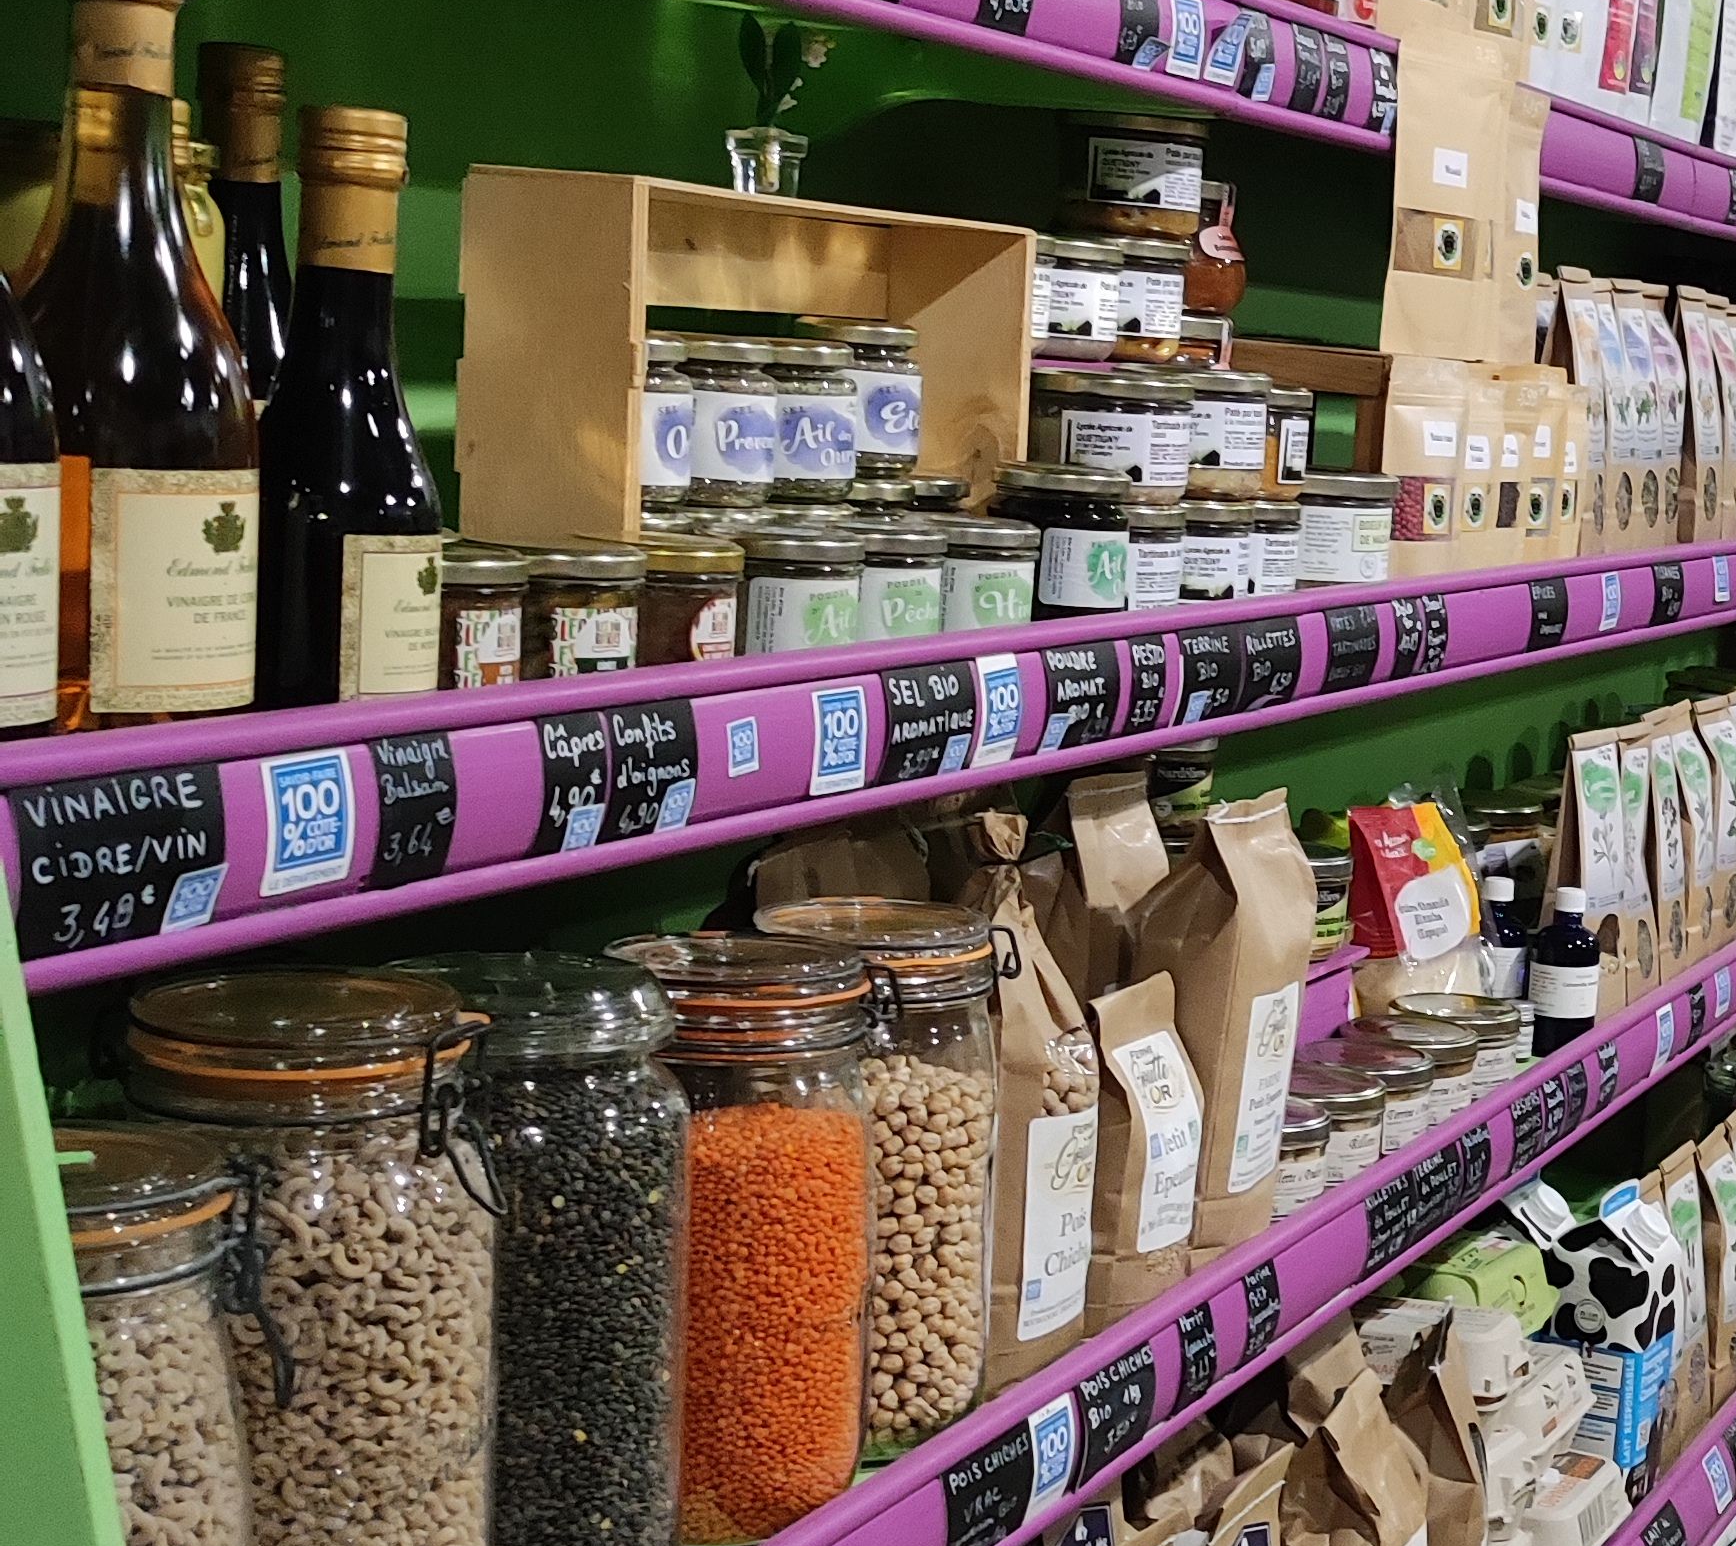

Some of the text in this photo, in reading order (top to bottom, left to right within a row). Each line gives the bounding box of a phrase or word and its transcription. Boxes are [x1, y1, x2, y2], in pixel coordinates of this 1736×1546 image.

[887, 676, 926, 708] SEL
[986, 684, 1021, 715] 100
[612, 710, 678, 761] Confits
[822, 708, 861, 741] 100
[543, 721, 607, 768] Câpres
[281, 779, 341, 820] 100
[1037, 1425, 1069, 1461] 100
